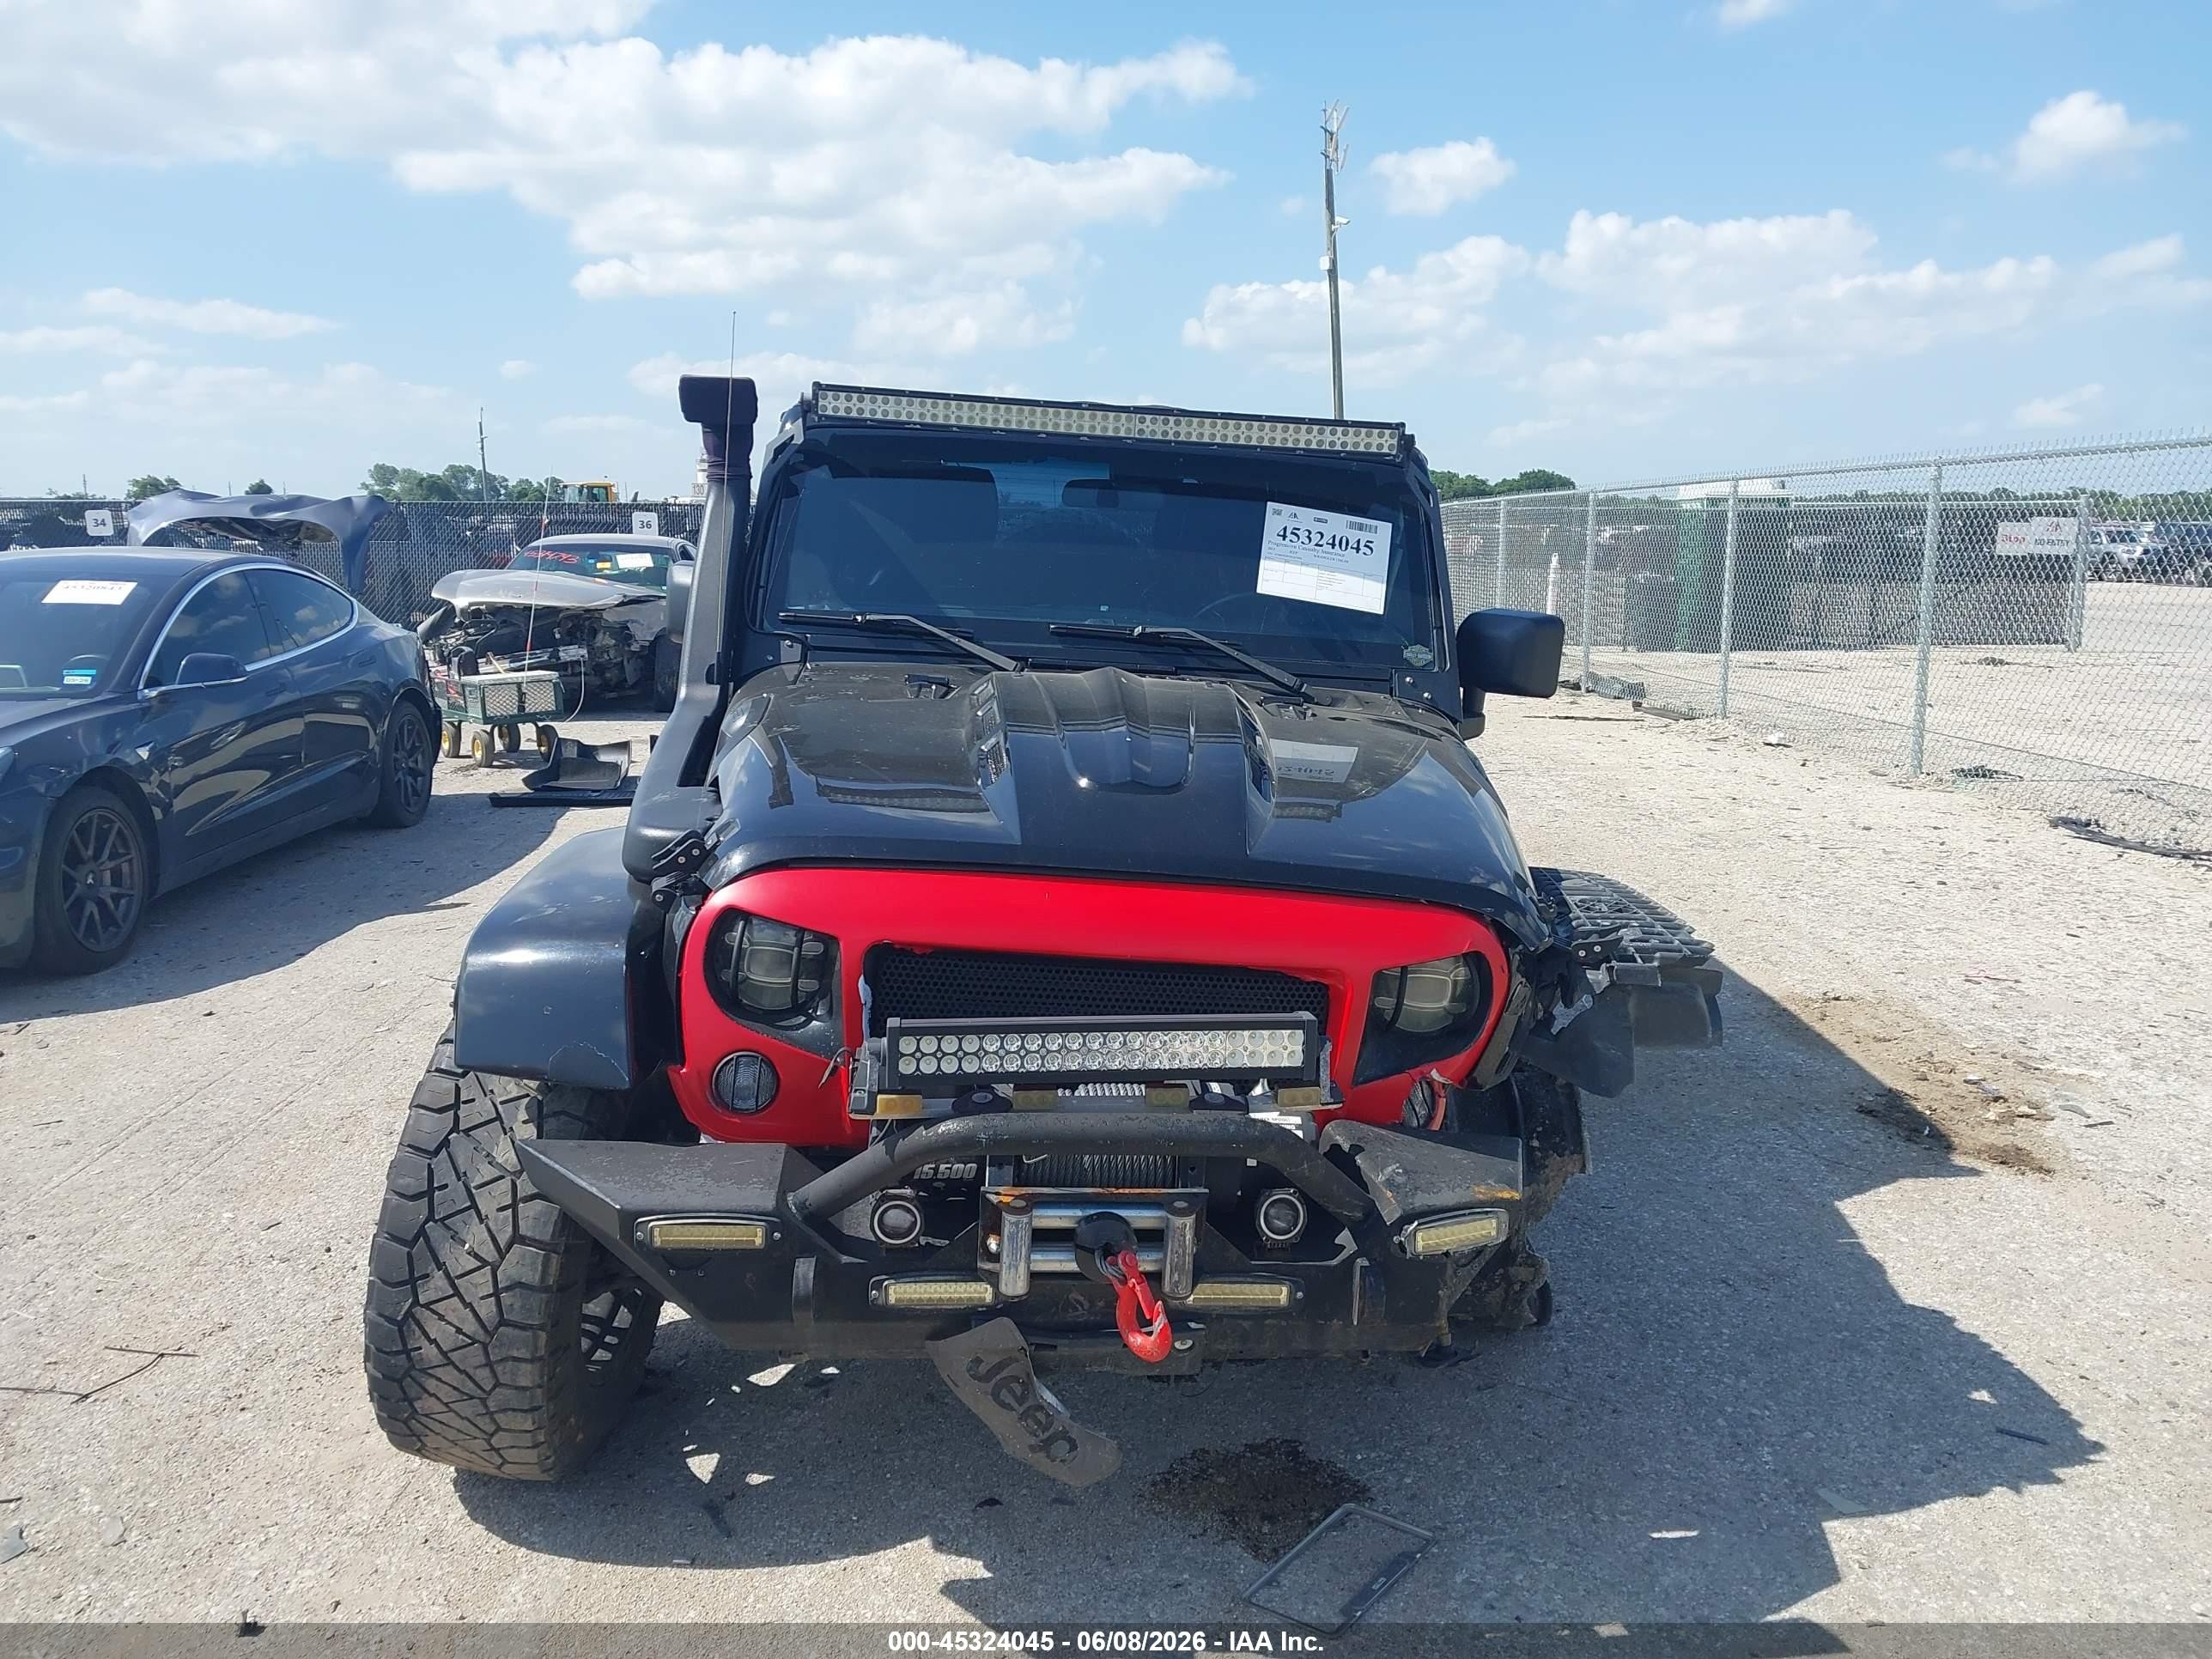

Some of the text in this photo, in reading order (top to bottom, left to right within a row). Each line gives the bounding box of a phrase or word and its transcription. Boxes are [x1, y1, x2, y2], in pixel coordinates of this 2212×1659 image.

[92, 518, 106, 528] 34
[638, 520, 653, 530] 36
[1276, 525, 1376, 556] 45324045
[2034, 538, 2045, 546] NO
[1267, 539, 1297, 550] Progressive
[1297, 544, 1320, 554] Casualty
[1320, 548, 1346, 558] Insurance
[966, 1353, 1079, 1465] Jeep
